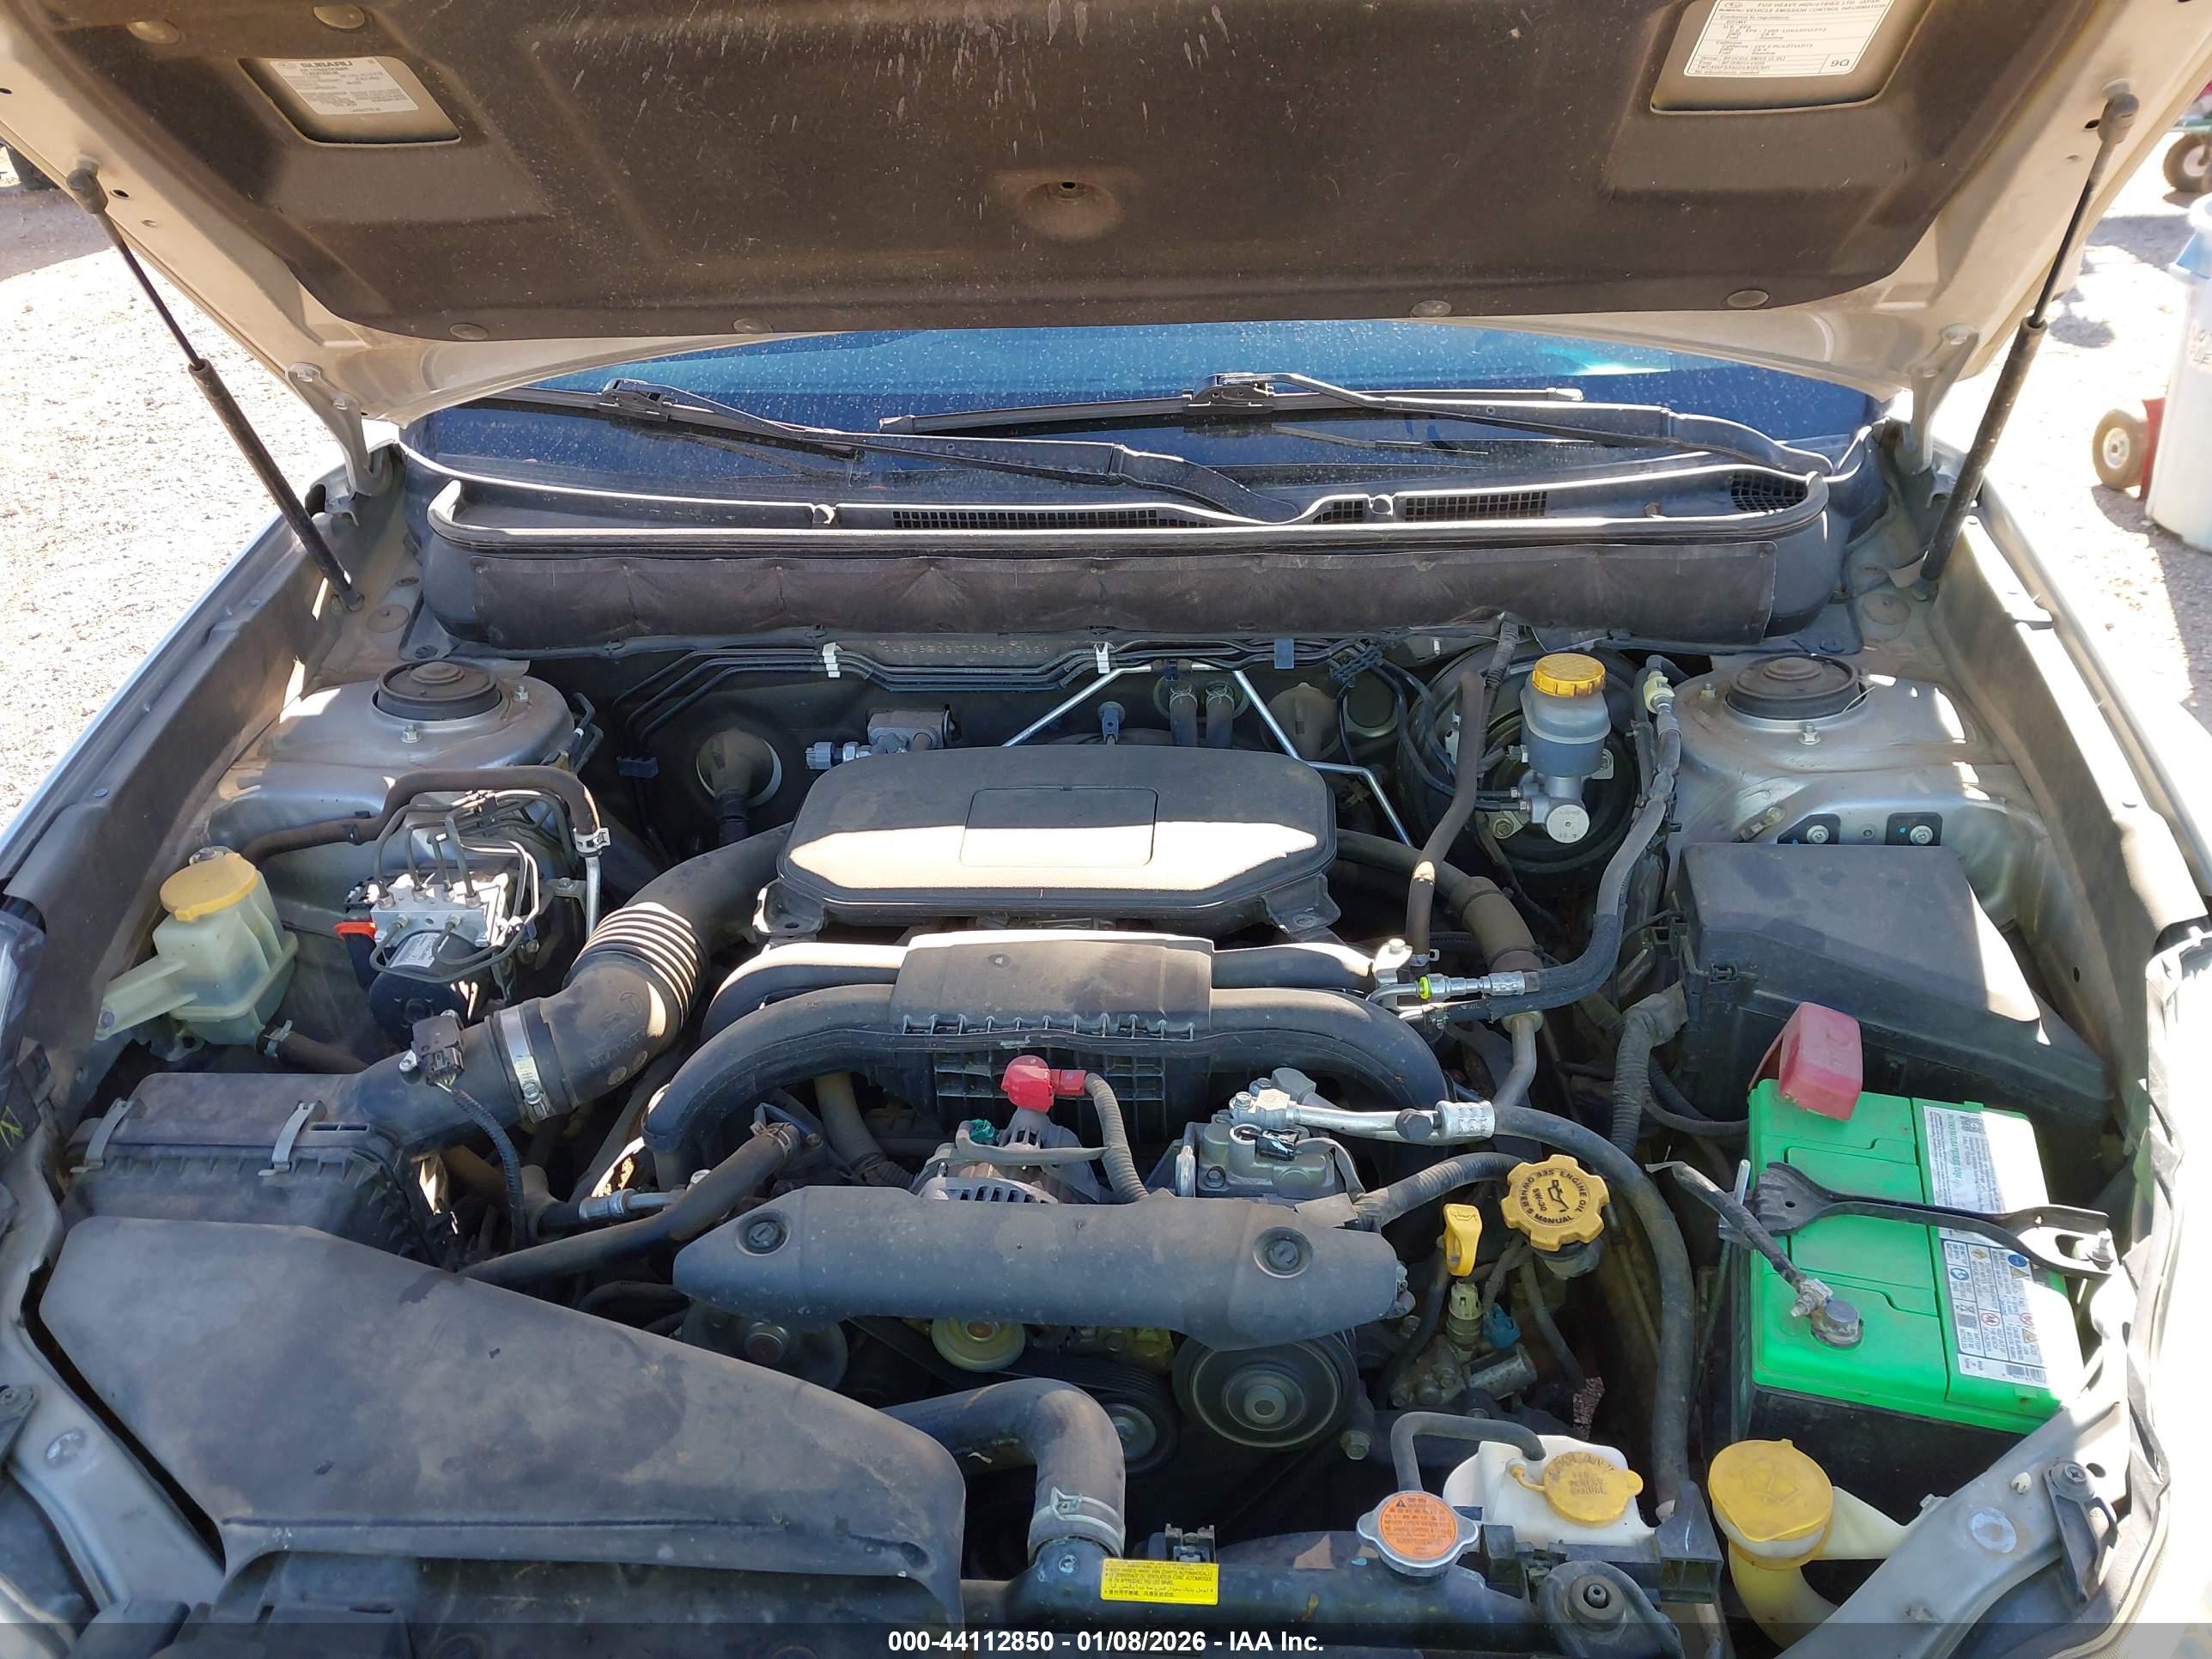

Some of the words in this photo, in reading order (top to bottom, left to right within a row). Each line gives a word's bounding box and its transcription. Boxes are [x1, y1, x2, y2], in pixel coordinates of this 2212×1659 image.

[1536, 1169, 1555, 1179] SEE
[1559, 1170, 1588, 1198] ENGINE
[1575, 1199, 1588, 1212] OIL
[1533, 1188, 1547, 1212] 5W-30
[1534, 1213, 1574, 1224] MANUAL
